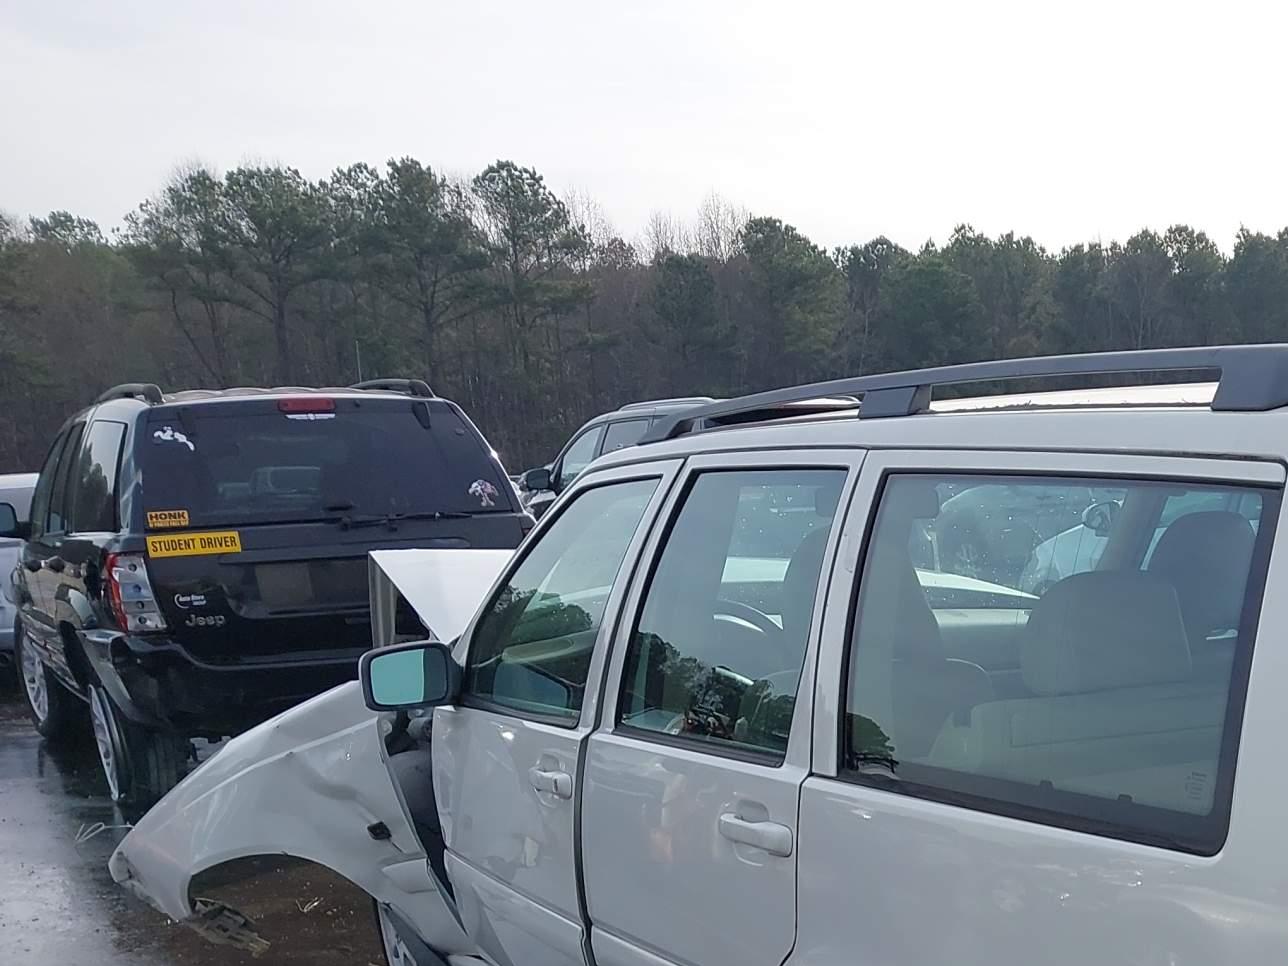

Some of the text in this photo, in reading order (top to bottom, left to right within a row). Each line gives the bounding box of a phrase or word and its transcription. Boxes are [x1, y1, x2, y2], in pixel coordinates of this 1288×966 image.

[149, 511, 187, 521] HONK
[150, 536, 238, 553] STUDENT DRIVER
[185, 614, 226, 628] Jeep
